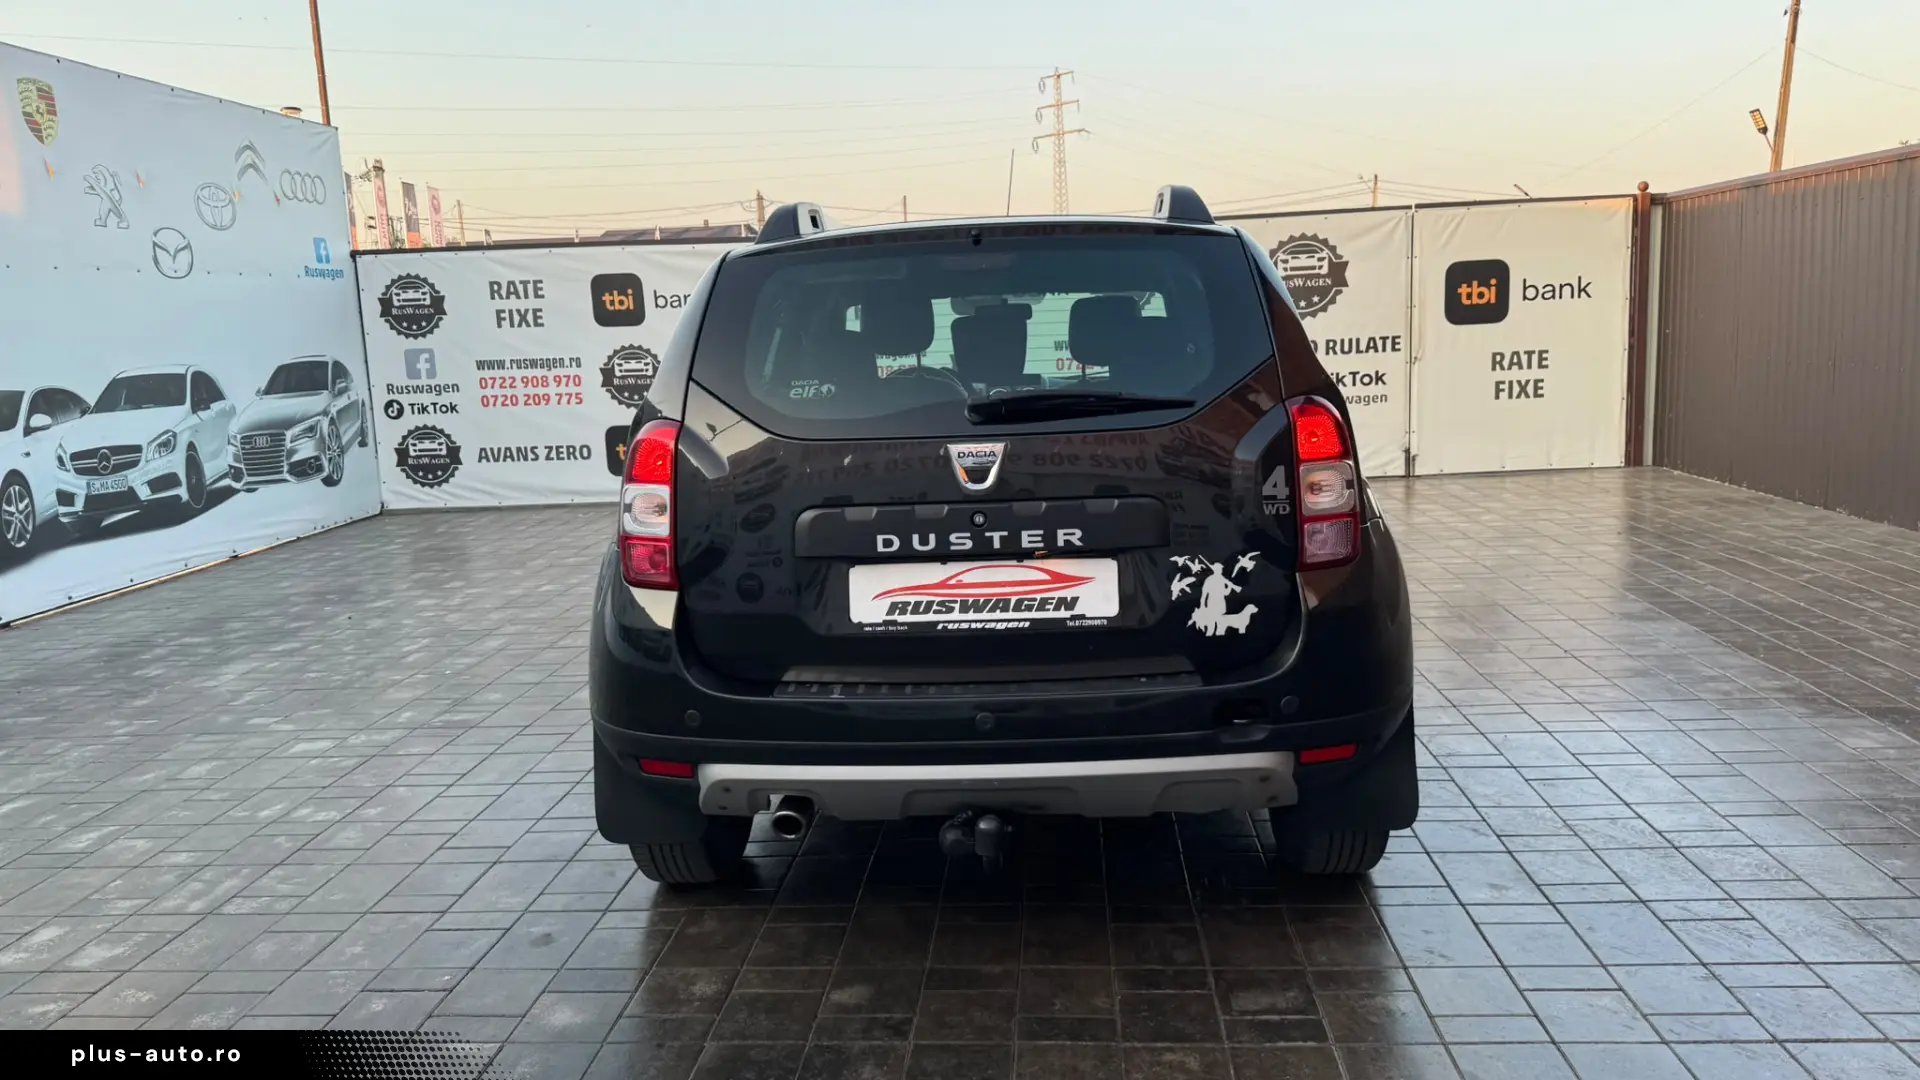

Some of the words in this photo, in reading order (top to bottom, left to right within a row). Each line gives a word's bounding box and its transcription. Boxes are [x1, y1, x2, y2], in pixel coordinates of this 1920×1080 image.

[304, 265, 344, 280] Ruswagen
[489, 279, 545, 300] RATE
[1457, 278, 1497, 305] tbi
[1522, 276, 1592, 301] bank
[602, 288, 635, 311] tbi
[653, 289, 691, 309] ba
[495, 308, 545, 328] FIXE
[1325, 335, 1402, 356] RULATE
[475, 355, 582, 372] www.ruswagen.ro
[1490, 349, 1549, 372] RATE
[479, 376, 517, 390] 0722
[520, 375, 549, 389] 908
[553, 374, 582, 388] 970
[1330, 370, 1387, 387] ikTok
[386, 381, 460, 397] Ruswagen
[1494, 378, 1544, 400] FIXE
[408, 401, 459, 416] TikTok
[480, 394, 520, 408] 0720
[523, 393, 551, 407] 209
[555, 392, 583, 407] 775
[1344, 394, 1388, 406] wagen
[477, 445, 540, 464] AVANS
[544, 443, 592, 462] ZERO
[957, 449, 998, 460] DACIA
[1262, 465, 1290, 500] 4
[1262, 503, 1290, 515] WD
[876, 528, 1084, 553] DUSTER
[885, 596, 1080, 616] RUSWAGEN
[937, 620, 1030, 630] ruswagen
